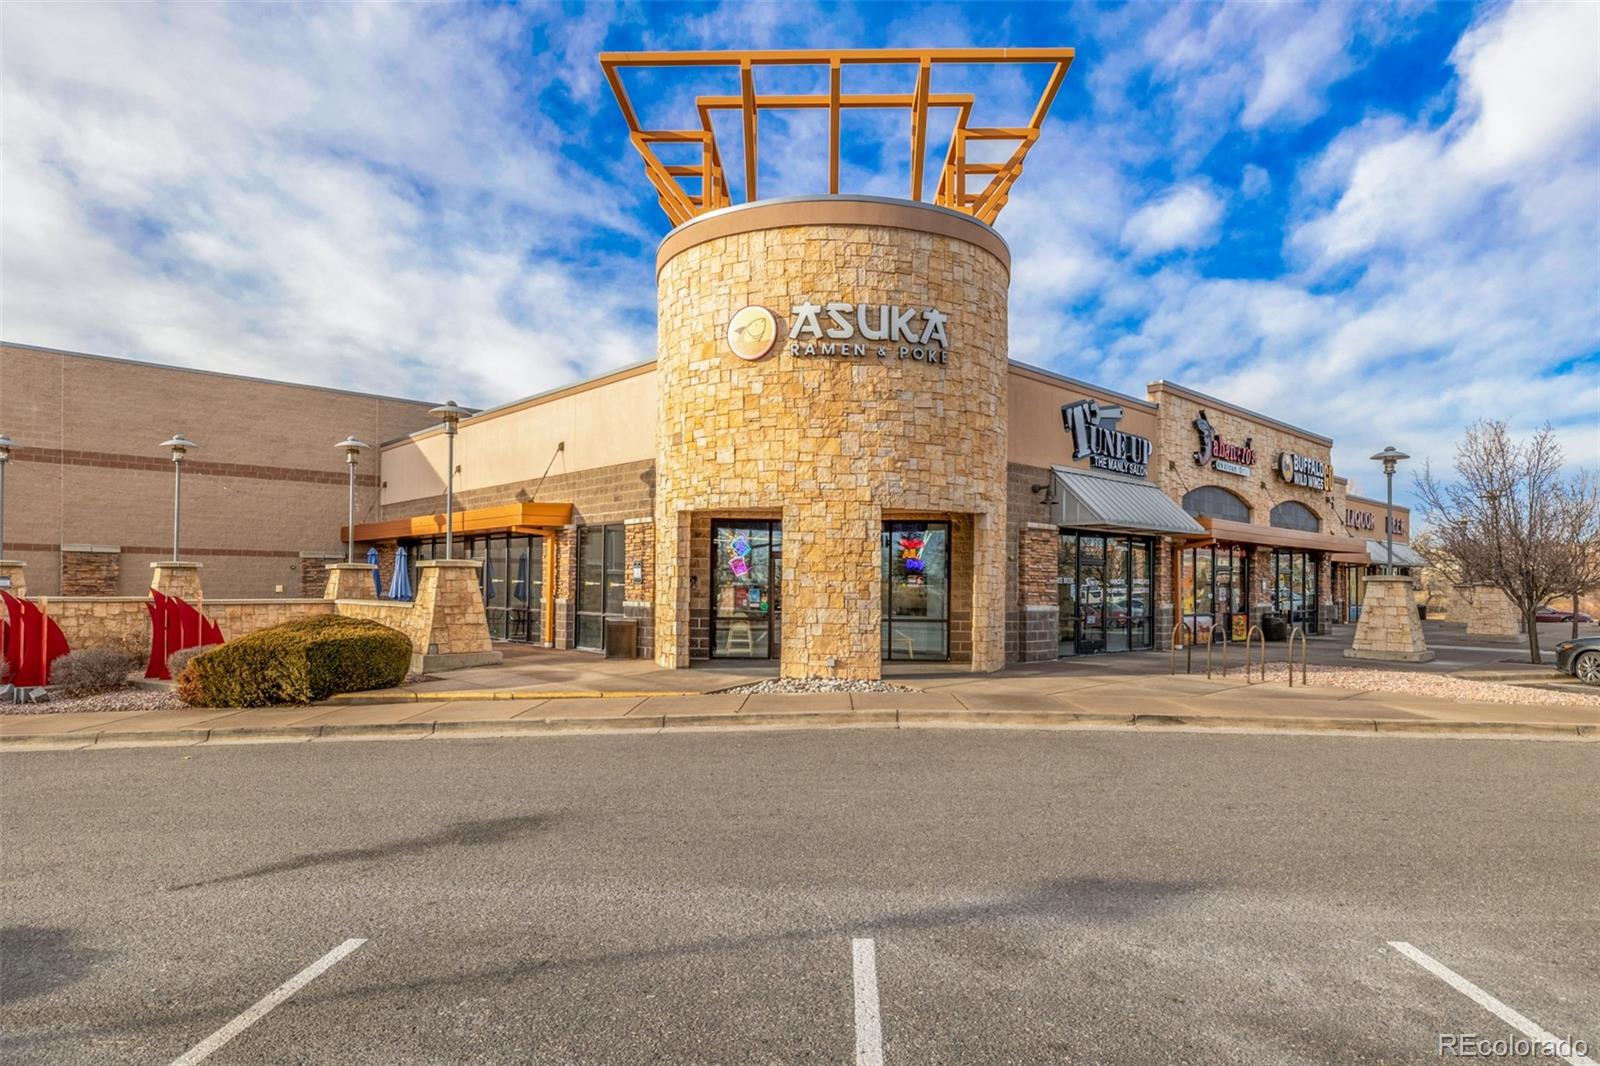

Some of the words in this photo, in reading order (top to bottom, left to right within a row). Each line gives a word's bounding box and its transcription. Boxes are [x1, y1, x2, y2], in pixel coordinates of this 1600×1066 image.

[789, 302, 948, 347] ASUKA
[790, 344, 866, 357] RAMEN
[877, 346, 886, 358] &
[900, 346, 948, 364] POKE
[1094, 455, 1107, 468] THE
[1108, 458, 1128, 473] MANLY
[1129, 463, 1149, 477] SALON
[1294, 454, 1325, 478] BUFFALO
[1346, 509, 1376, 530] LIQUOR
